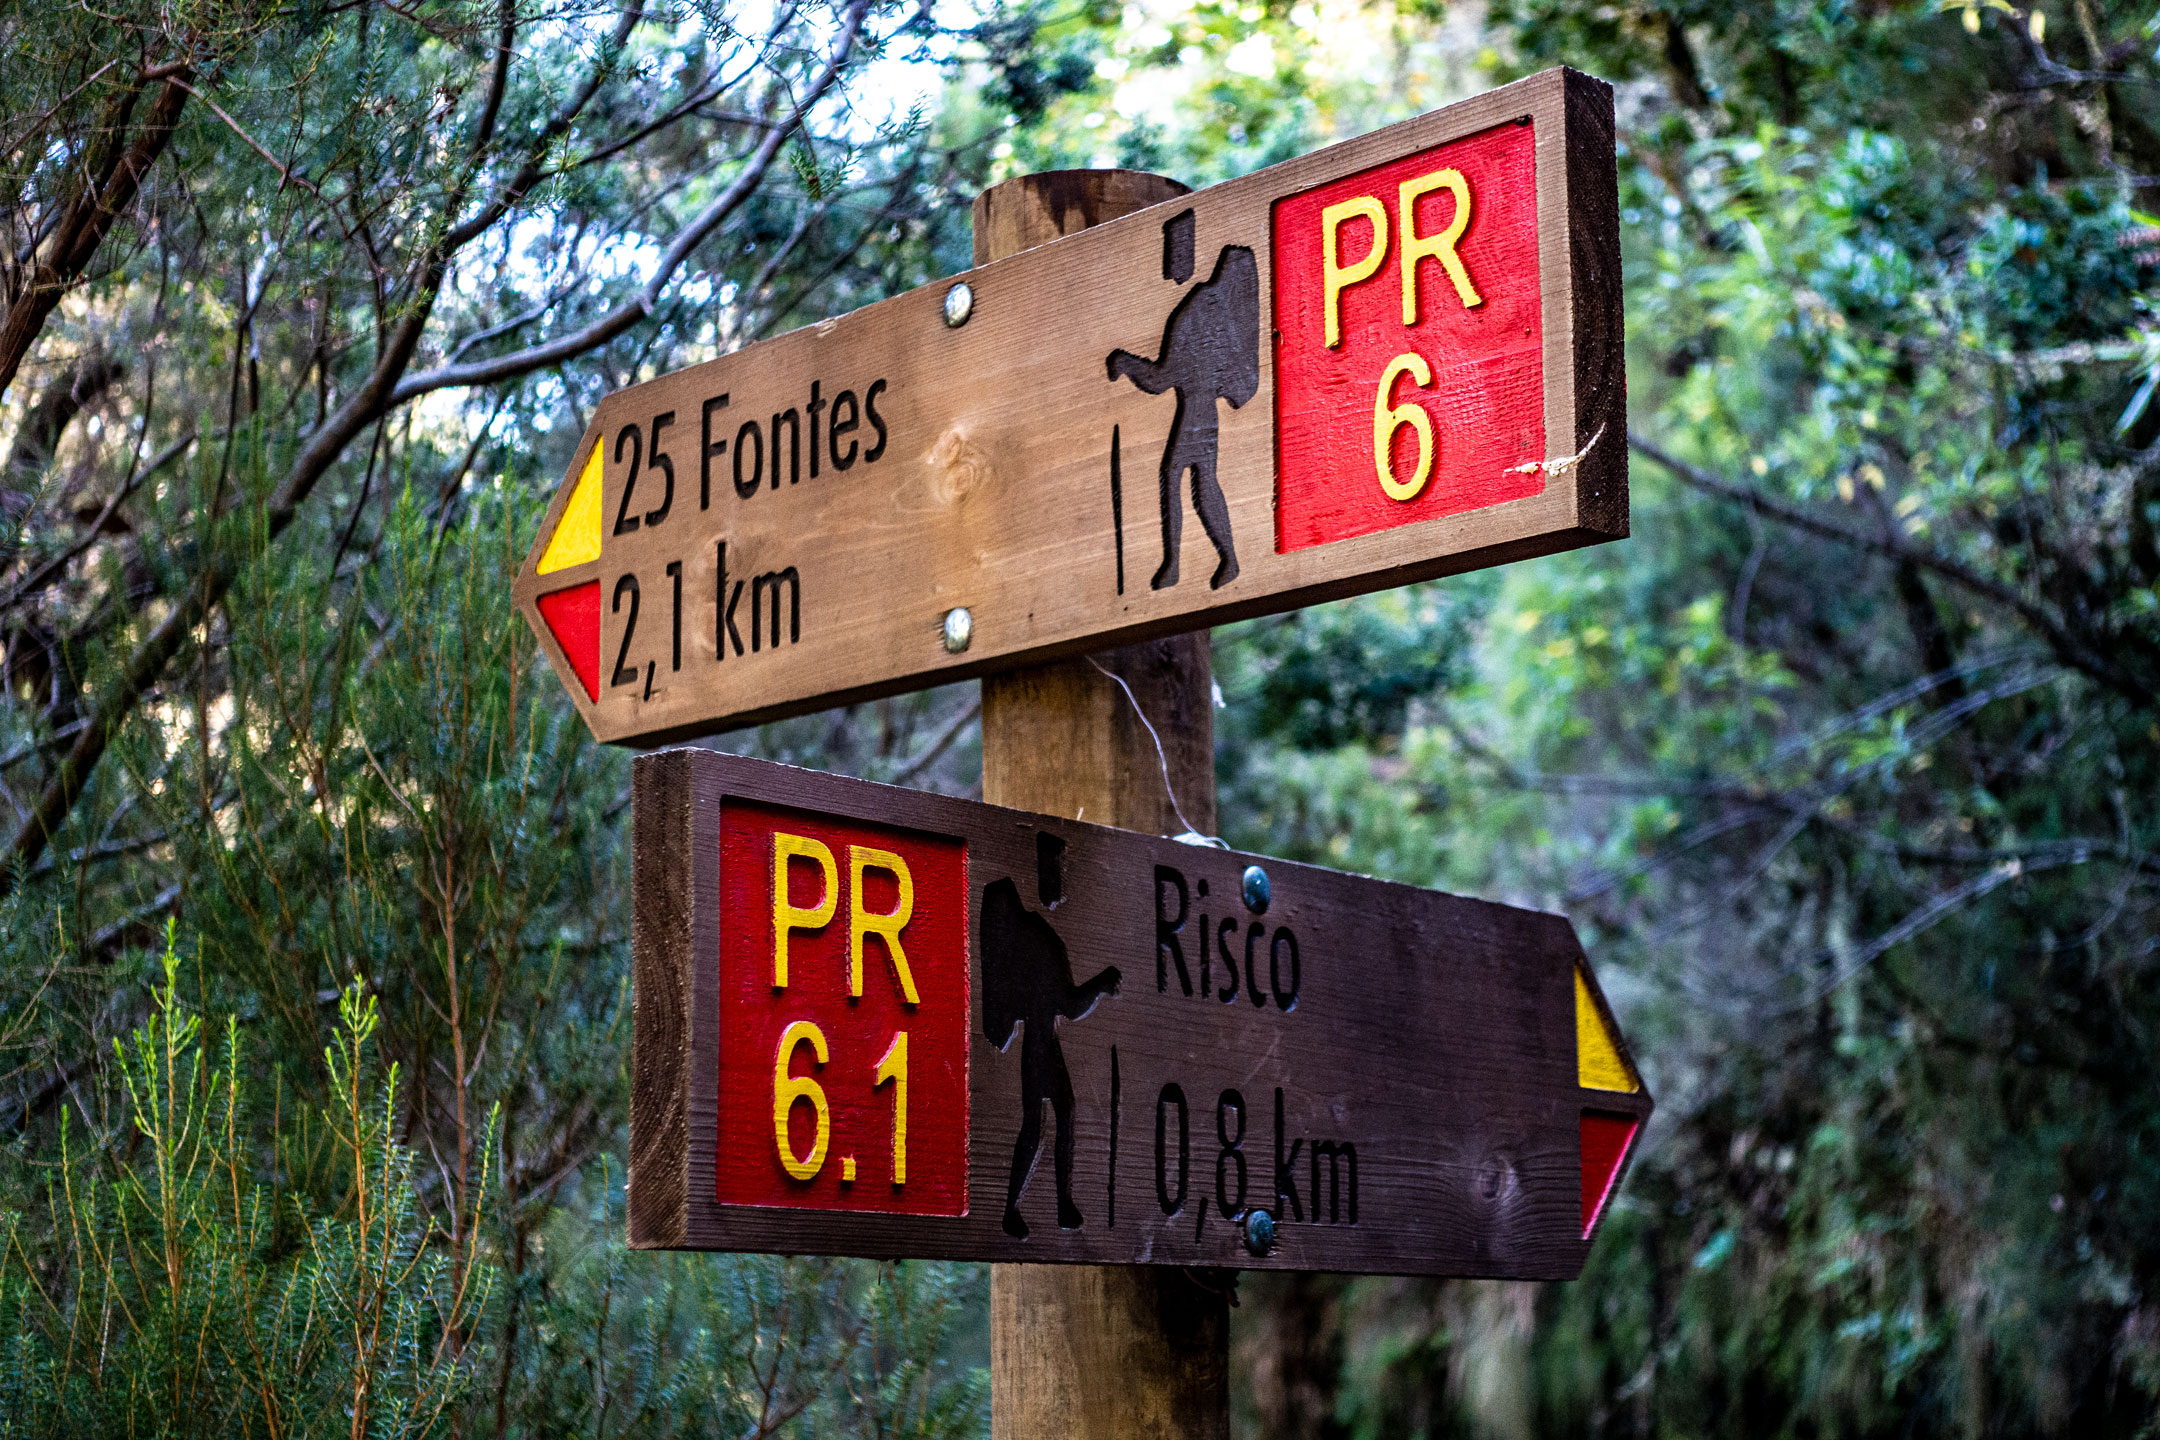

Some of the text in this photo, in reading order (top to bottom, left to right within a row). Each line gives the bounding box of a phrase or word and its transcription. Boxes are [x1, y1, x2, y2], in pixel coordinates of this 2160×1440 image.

[1321, 166, 1483, 349] PR
[612, 378, 888, 537] 25 Fontes
[1372, 351, 1436, 501] 6
[610, 540, 801, 702] 2,1 km
[771, 831, 921, 1004] PR
[1154, 863, 1300, 1013] Risco
[771, 1020, 909, 1185] 6.1
[1154, 1081, 1359, 1245] 0,8 km
